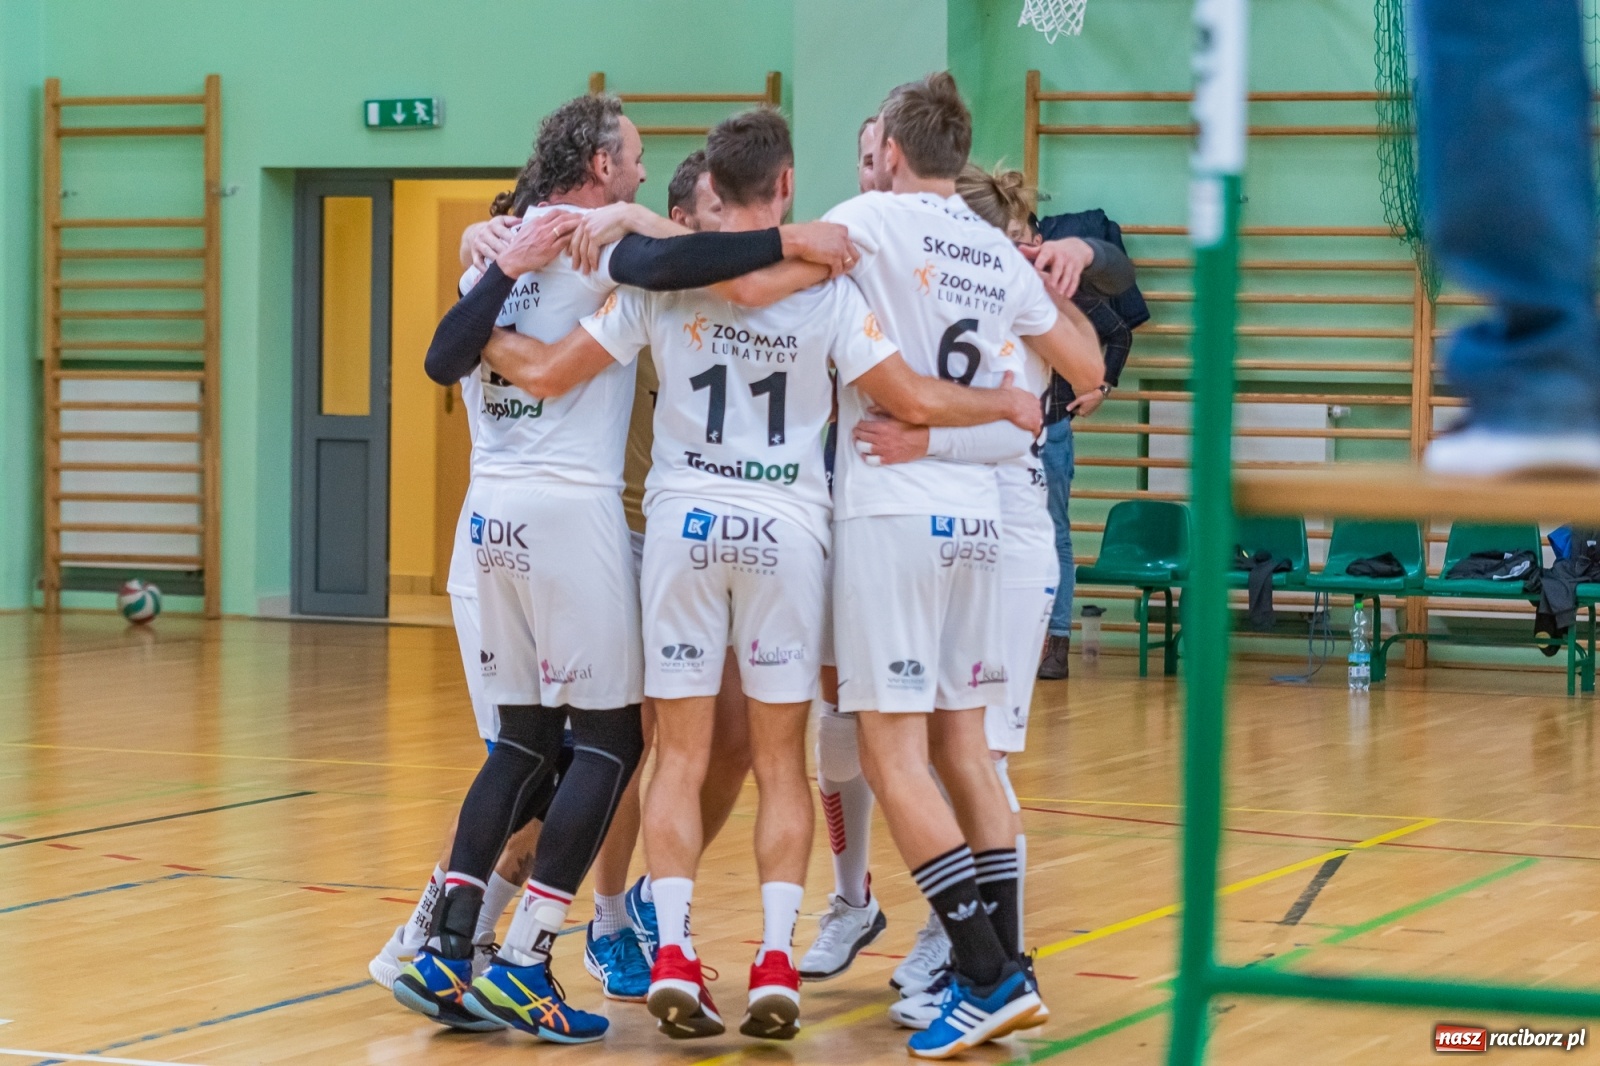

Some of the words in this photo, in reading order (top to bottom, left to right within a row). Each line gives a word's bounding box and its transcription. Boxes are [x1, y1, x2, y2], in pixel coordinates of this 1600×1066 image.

[923, 236, 1005, 273] SKORUPA
[501, 297, 541, 316] ATYCY
[508, 281, 541, 300] MAR
[937, 289, 1004, 317] LUNATYCY
[711, 342, 798, 364] LUNATYCY
[937, 318, 981, 386] 6
[488, 518, 529, 550] DK
[721, 515, 779, 544] DK
[476, 541, 531, 573] glass
[689, 538, 779, 570] glass
[940, 534, 999, 567] glass
